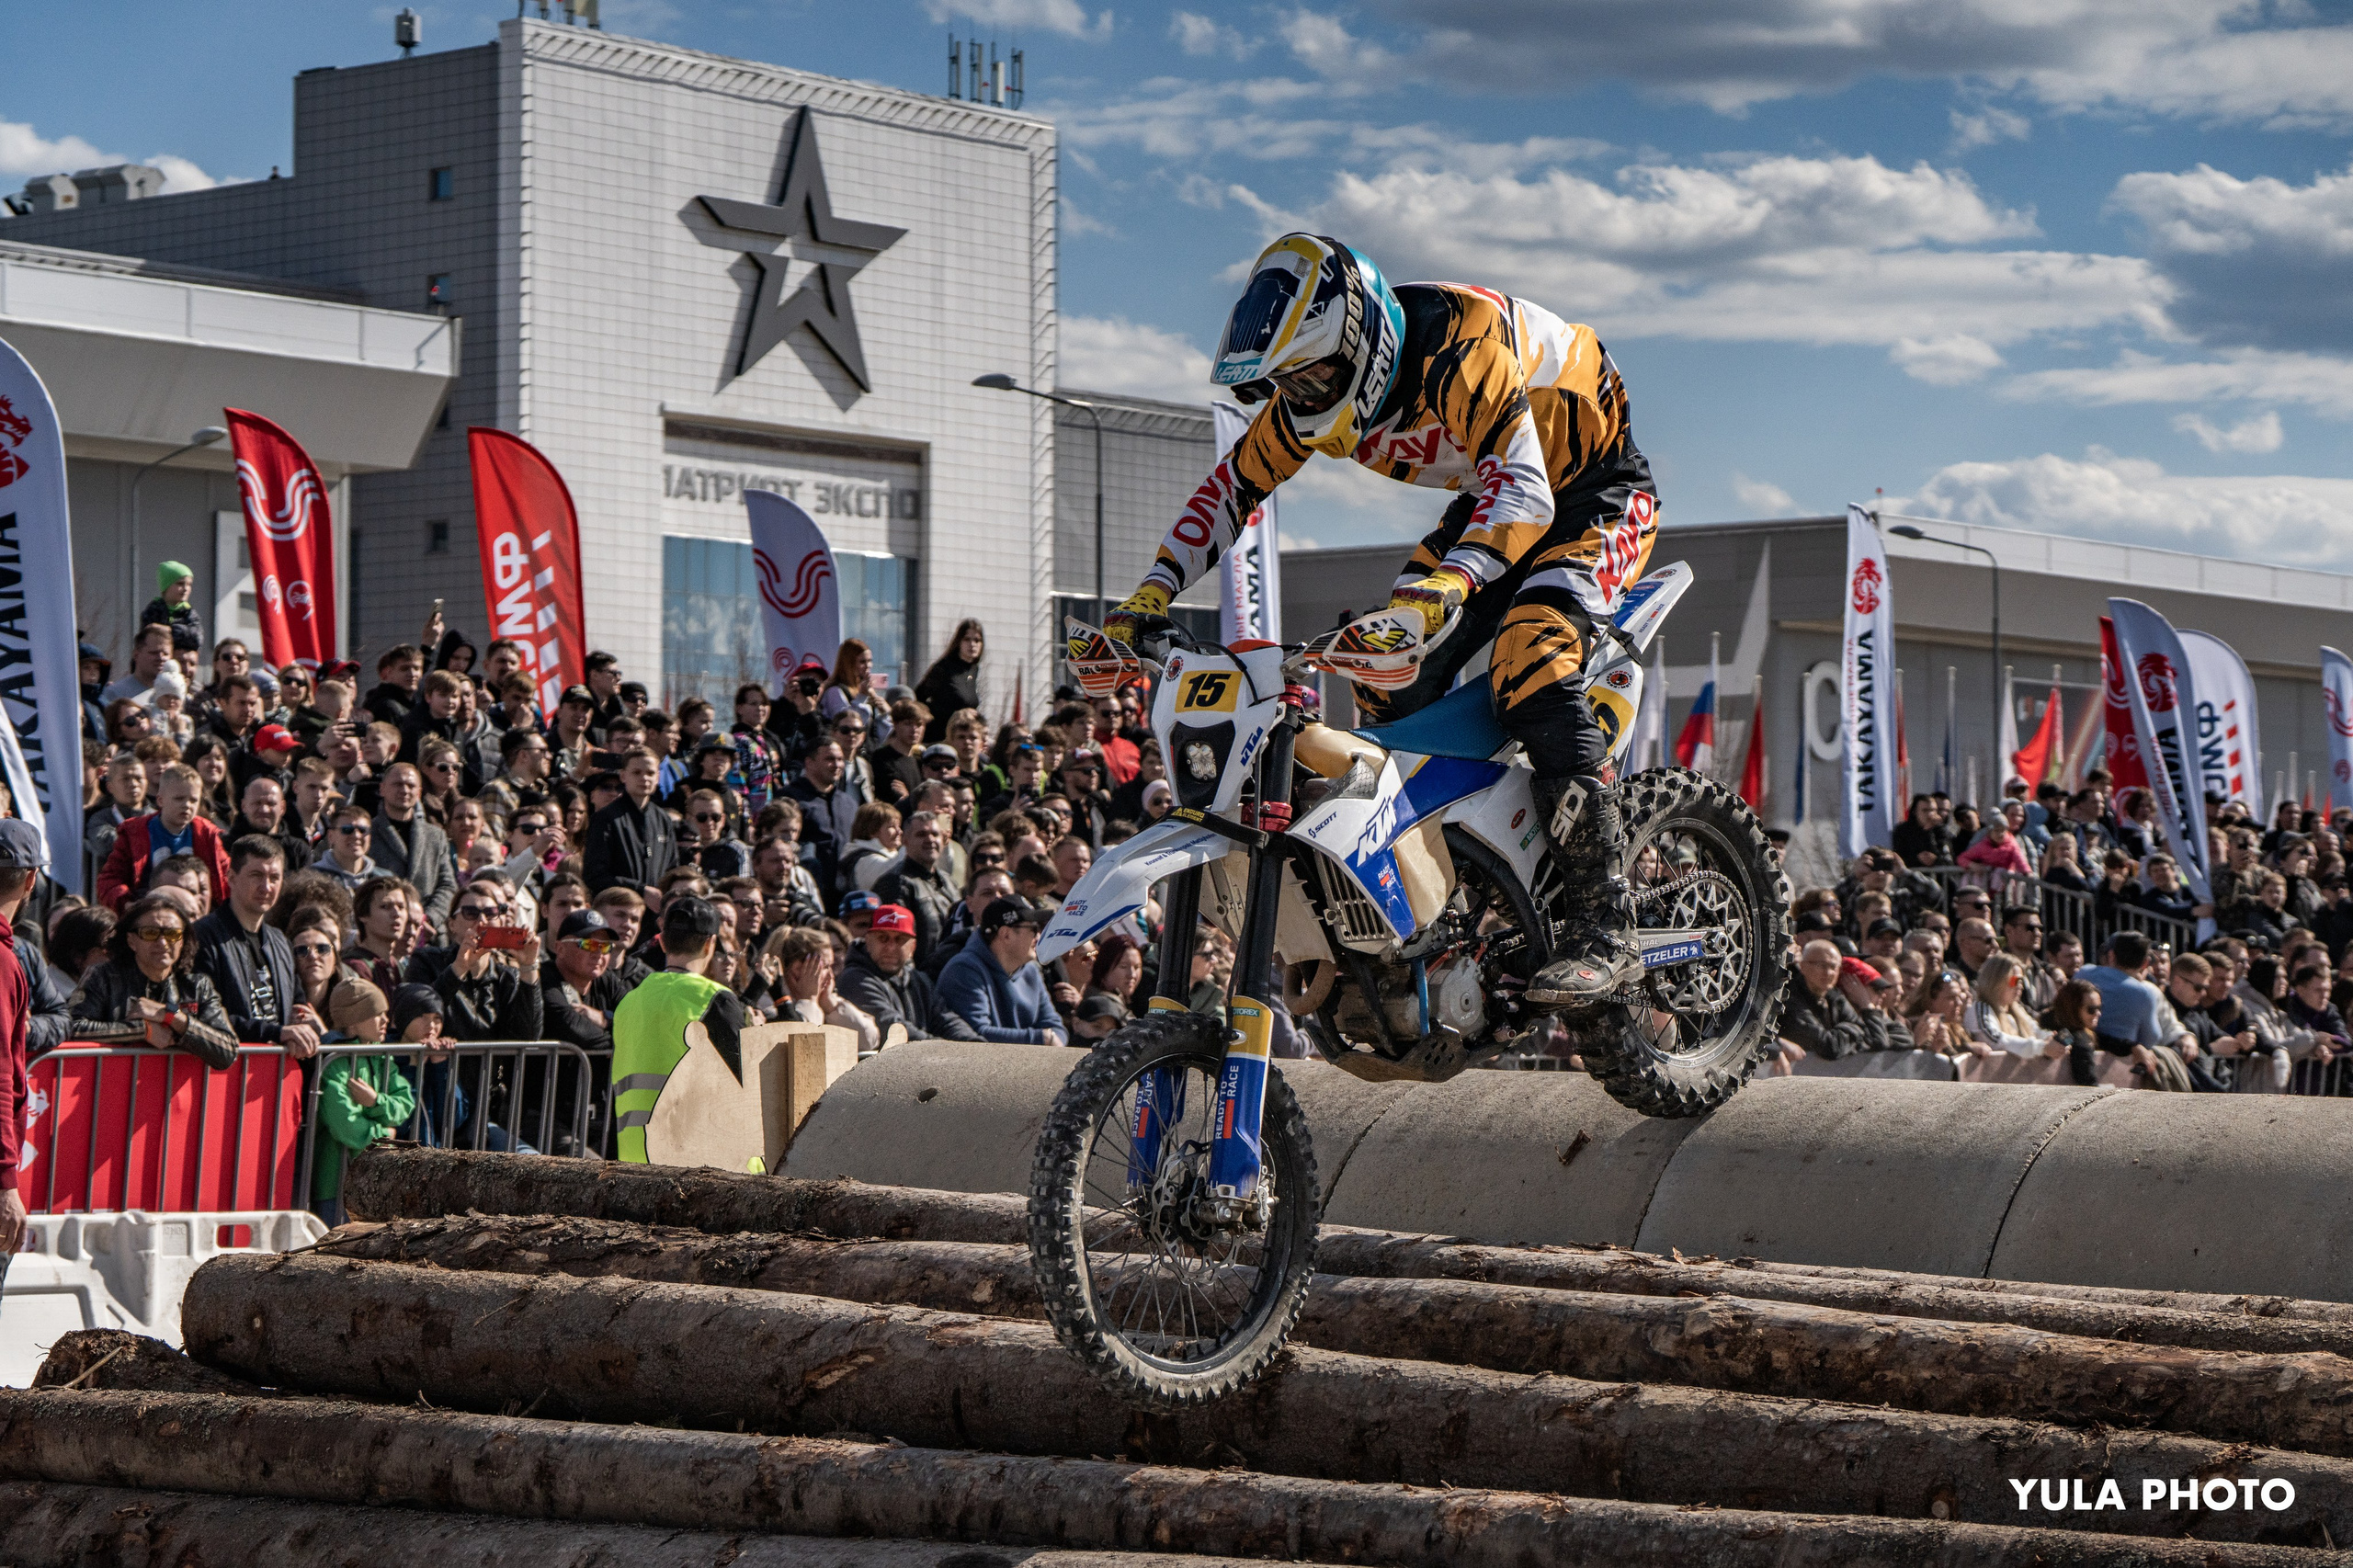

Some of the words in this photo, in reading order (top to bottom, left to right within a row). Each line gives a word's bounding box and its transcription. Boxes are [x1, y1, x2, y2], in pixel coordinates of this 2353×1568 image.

[1338, 263, 1364, 361] 100%
[813, 481, 920, 519] ЭКСПО
[0, 511, 51, 814] AKAYAM
[1183, 673, 1232, 708] 15
[1857, 630, 1874, 818] TAKAYAMA
[1241, 726, 1264, 767] KTM
[1314, 812, 1337, 834] SCOTT
[1357, 795, 1397, 868] KTM
[1046, 928, 1078, 938] KTM
[1226, 1064, 1240, 1097] RACE
[1214, 1099, 1226, 1140] READY
[1220, 1080, 1228, 1096] TO
